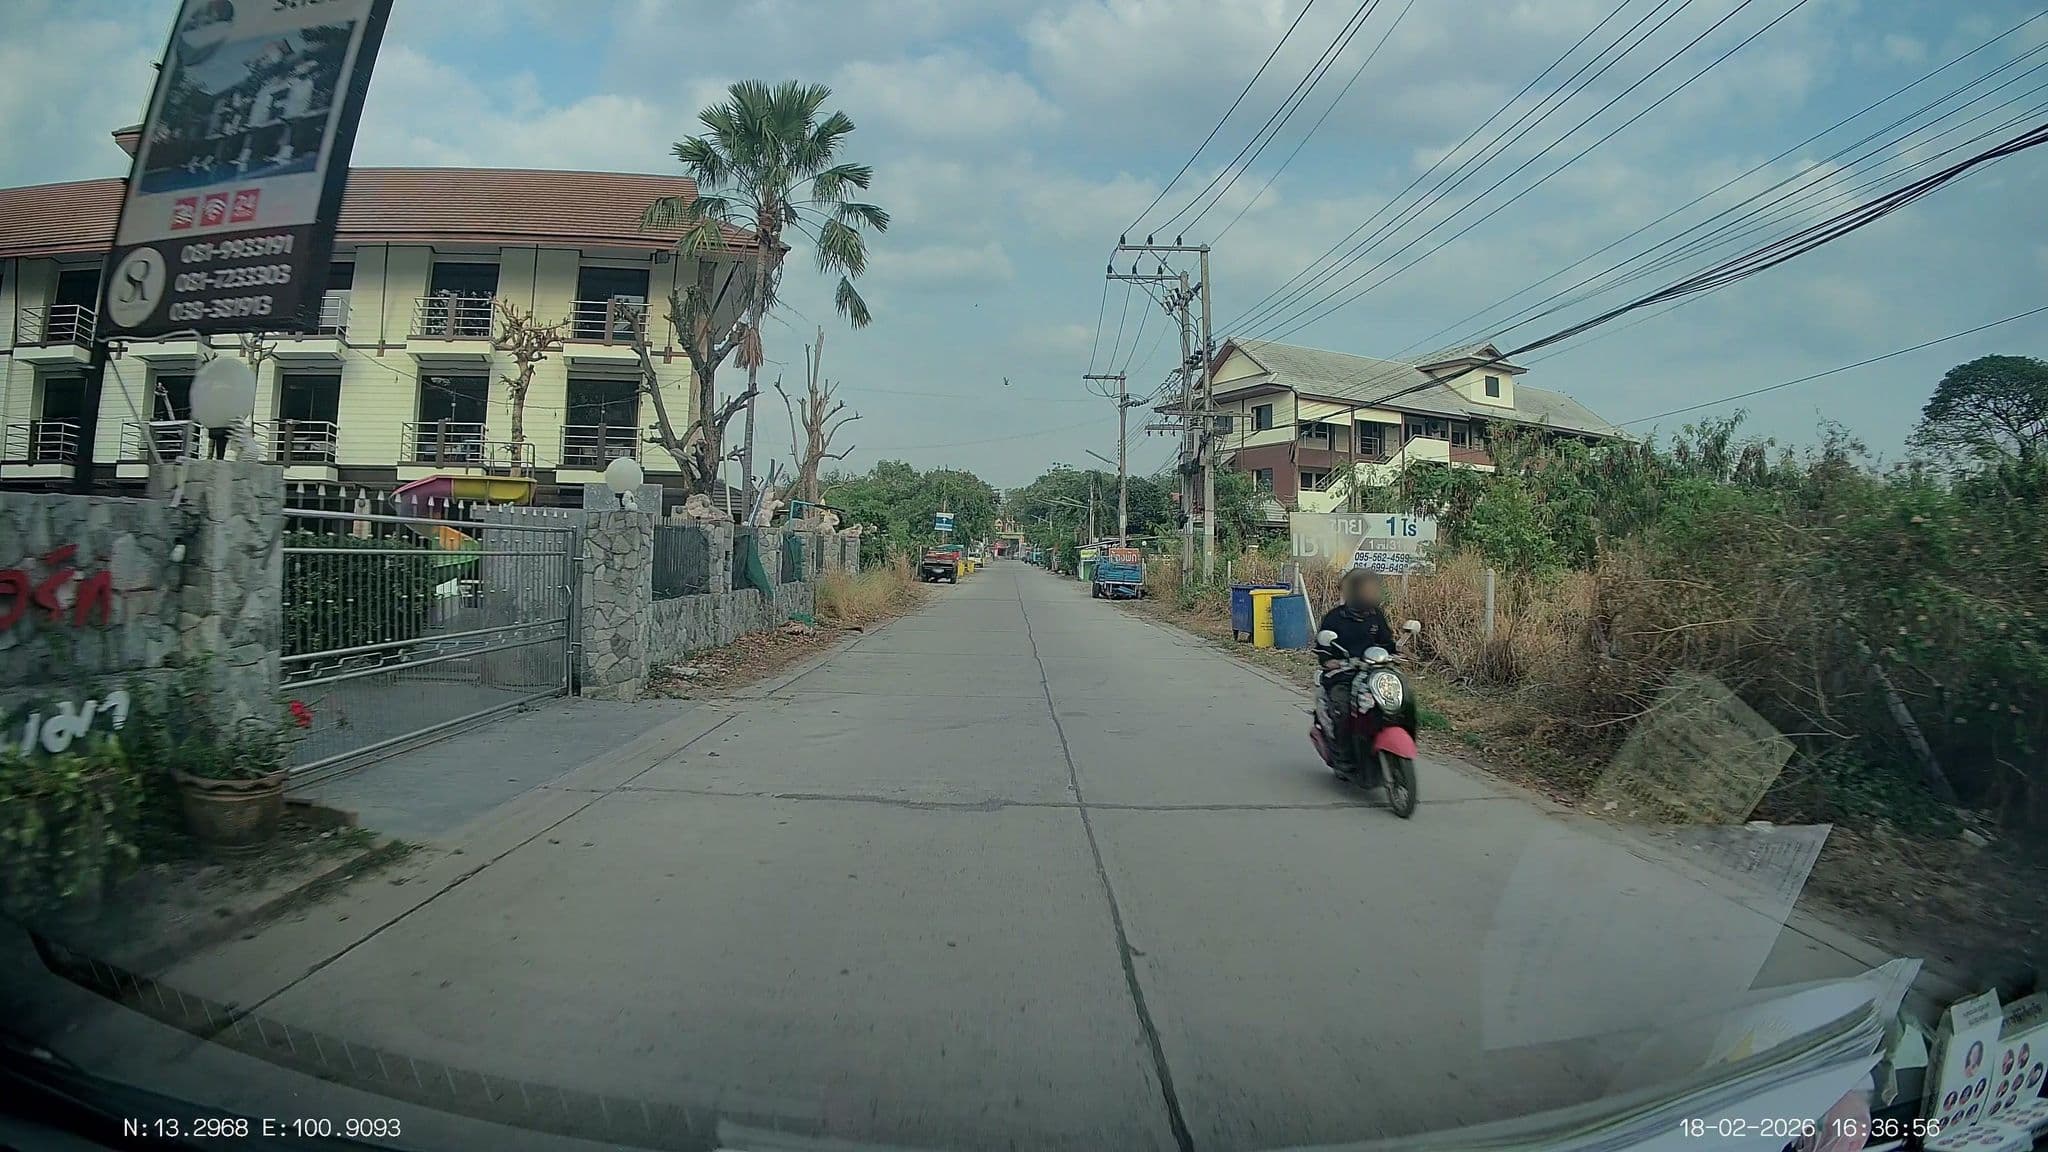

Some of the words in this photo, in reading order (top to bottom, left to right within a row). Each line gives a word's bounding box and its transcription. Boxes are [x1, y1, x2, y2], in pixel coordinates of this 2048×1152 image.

[1386, 517, 1395, 536] 1
[1401, 517, 1417, 537] ไร่
[1355, 552, 1410, 563] 095-562-4599
